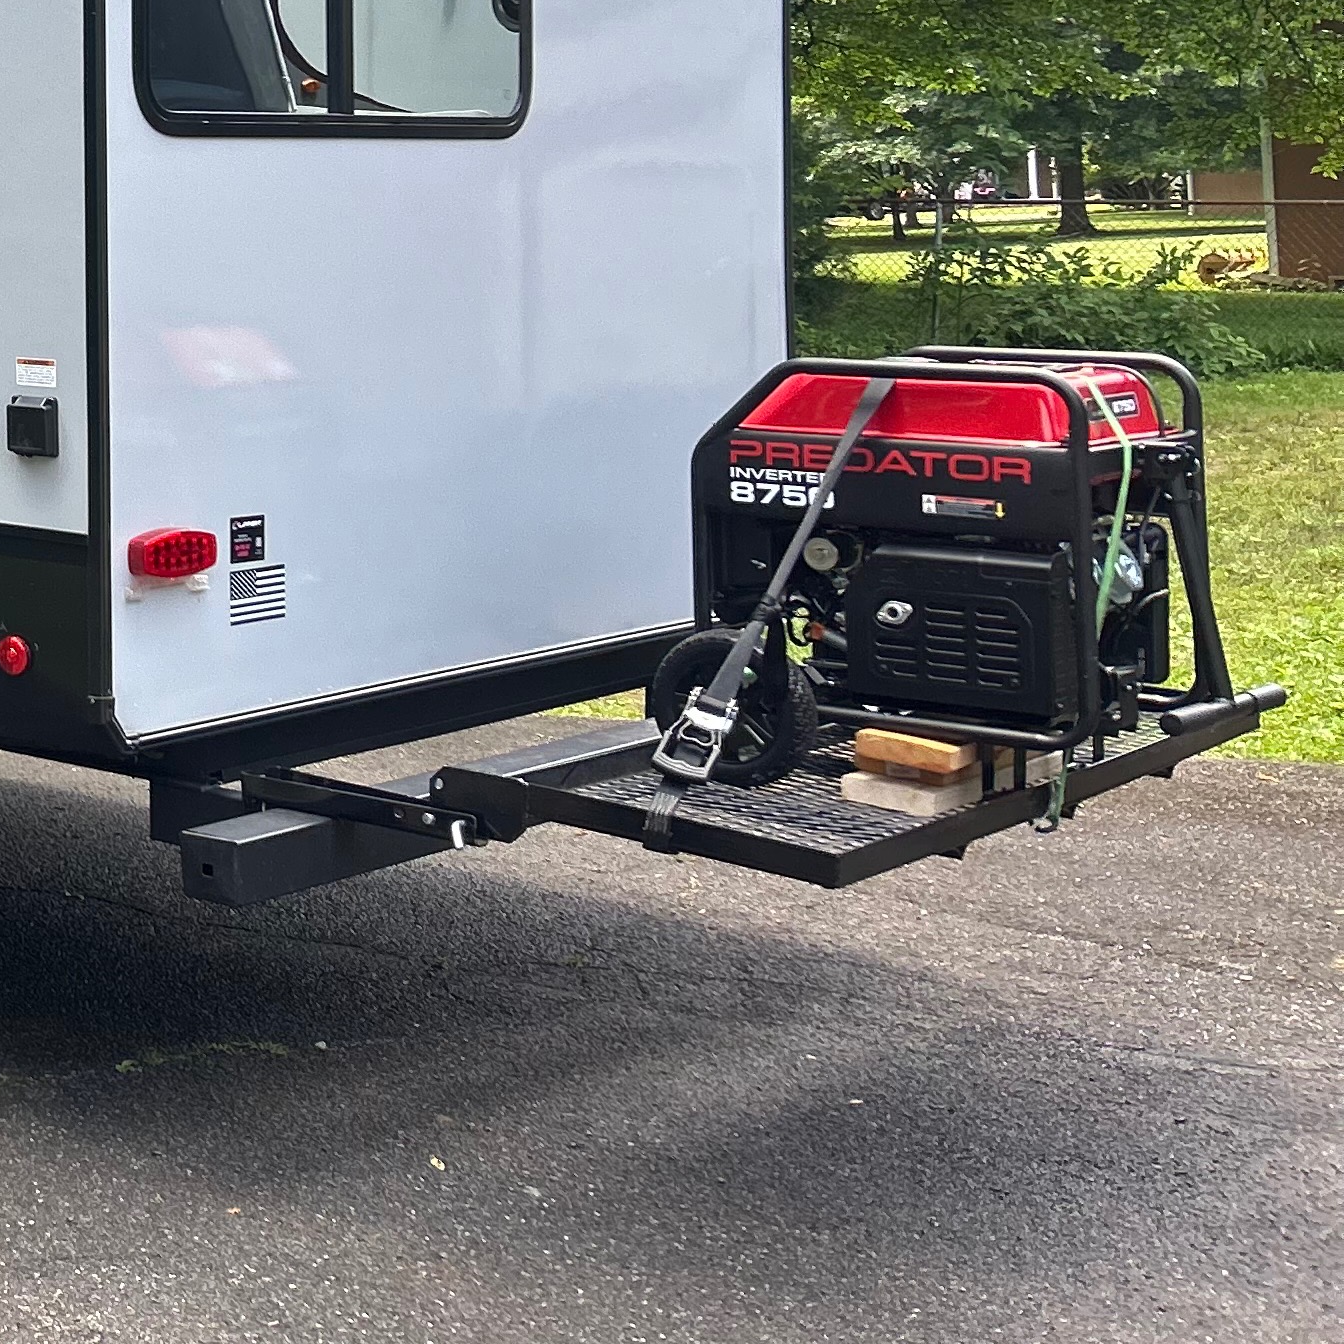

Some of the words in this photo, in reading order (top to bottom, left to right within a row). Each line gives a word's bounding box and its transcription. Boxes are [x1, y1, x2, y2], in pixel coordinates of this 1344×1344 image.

[729, 439, 1032, 485] PREDATOR
[729, 466, 826, 484] INVERTE
[730, 480, 835, 509] 8750
